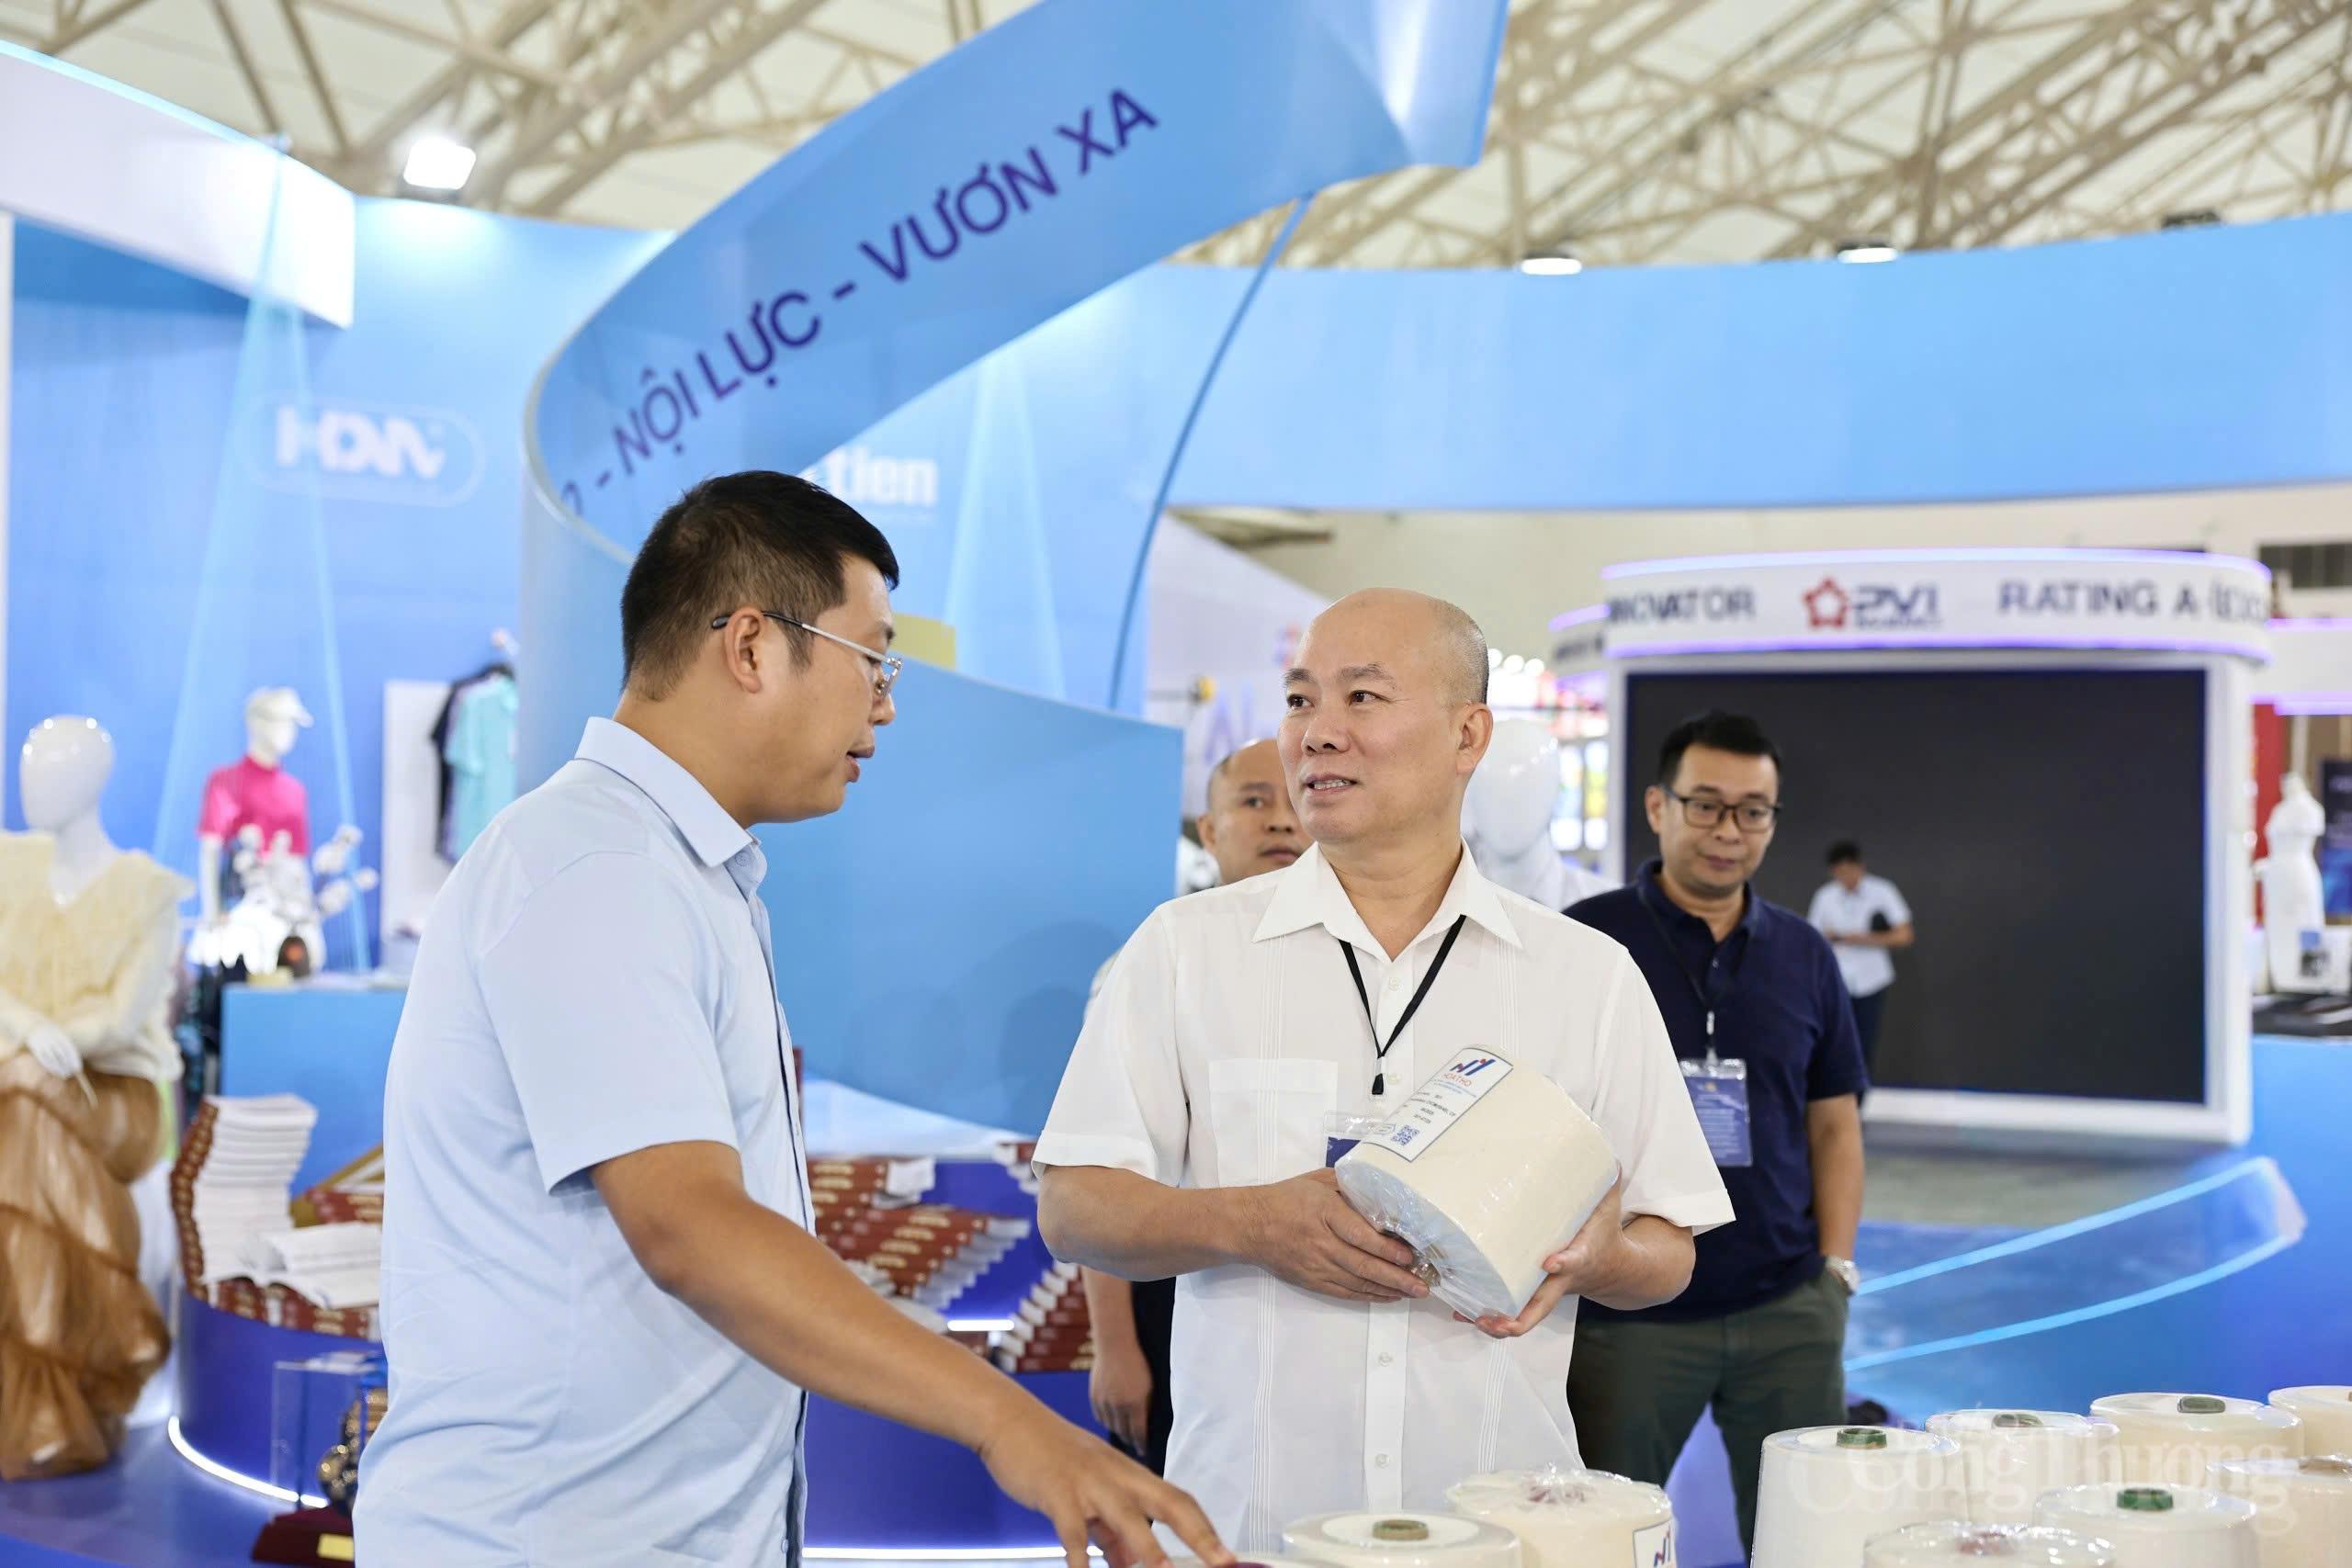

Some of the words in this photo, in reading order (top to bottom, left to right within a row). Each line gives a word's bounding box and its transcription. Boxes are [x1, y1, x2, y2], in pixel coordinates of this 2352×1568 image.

[614, 366, 700, 476] NỘI
[695, 291, 821, 400] LỰC
[858, 145, 1059, 284] VƯƠN
[1056, 88, 1159, 176] XA
[1998, 580, 2157, 615] RATING
